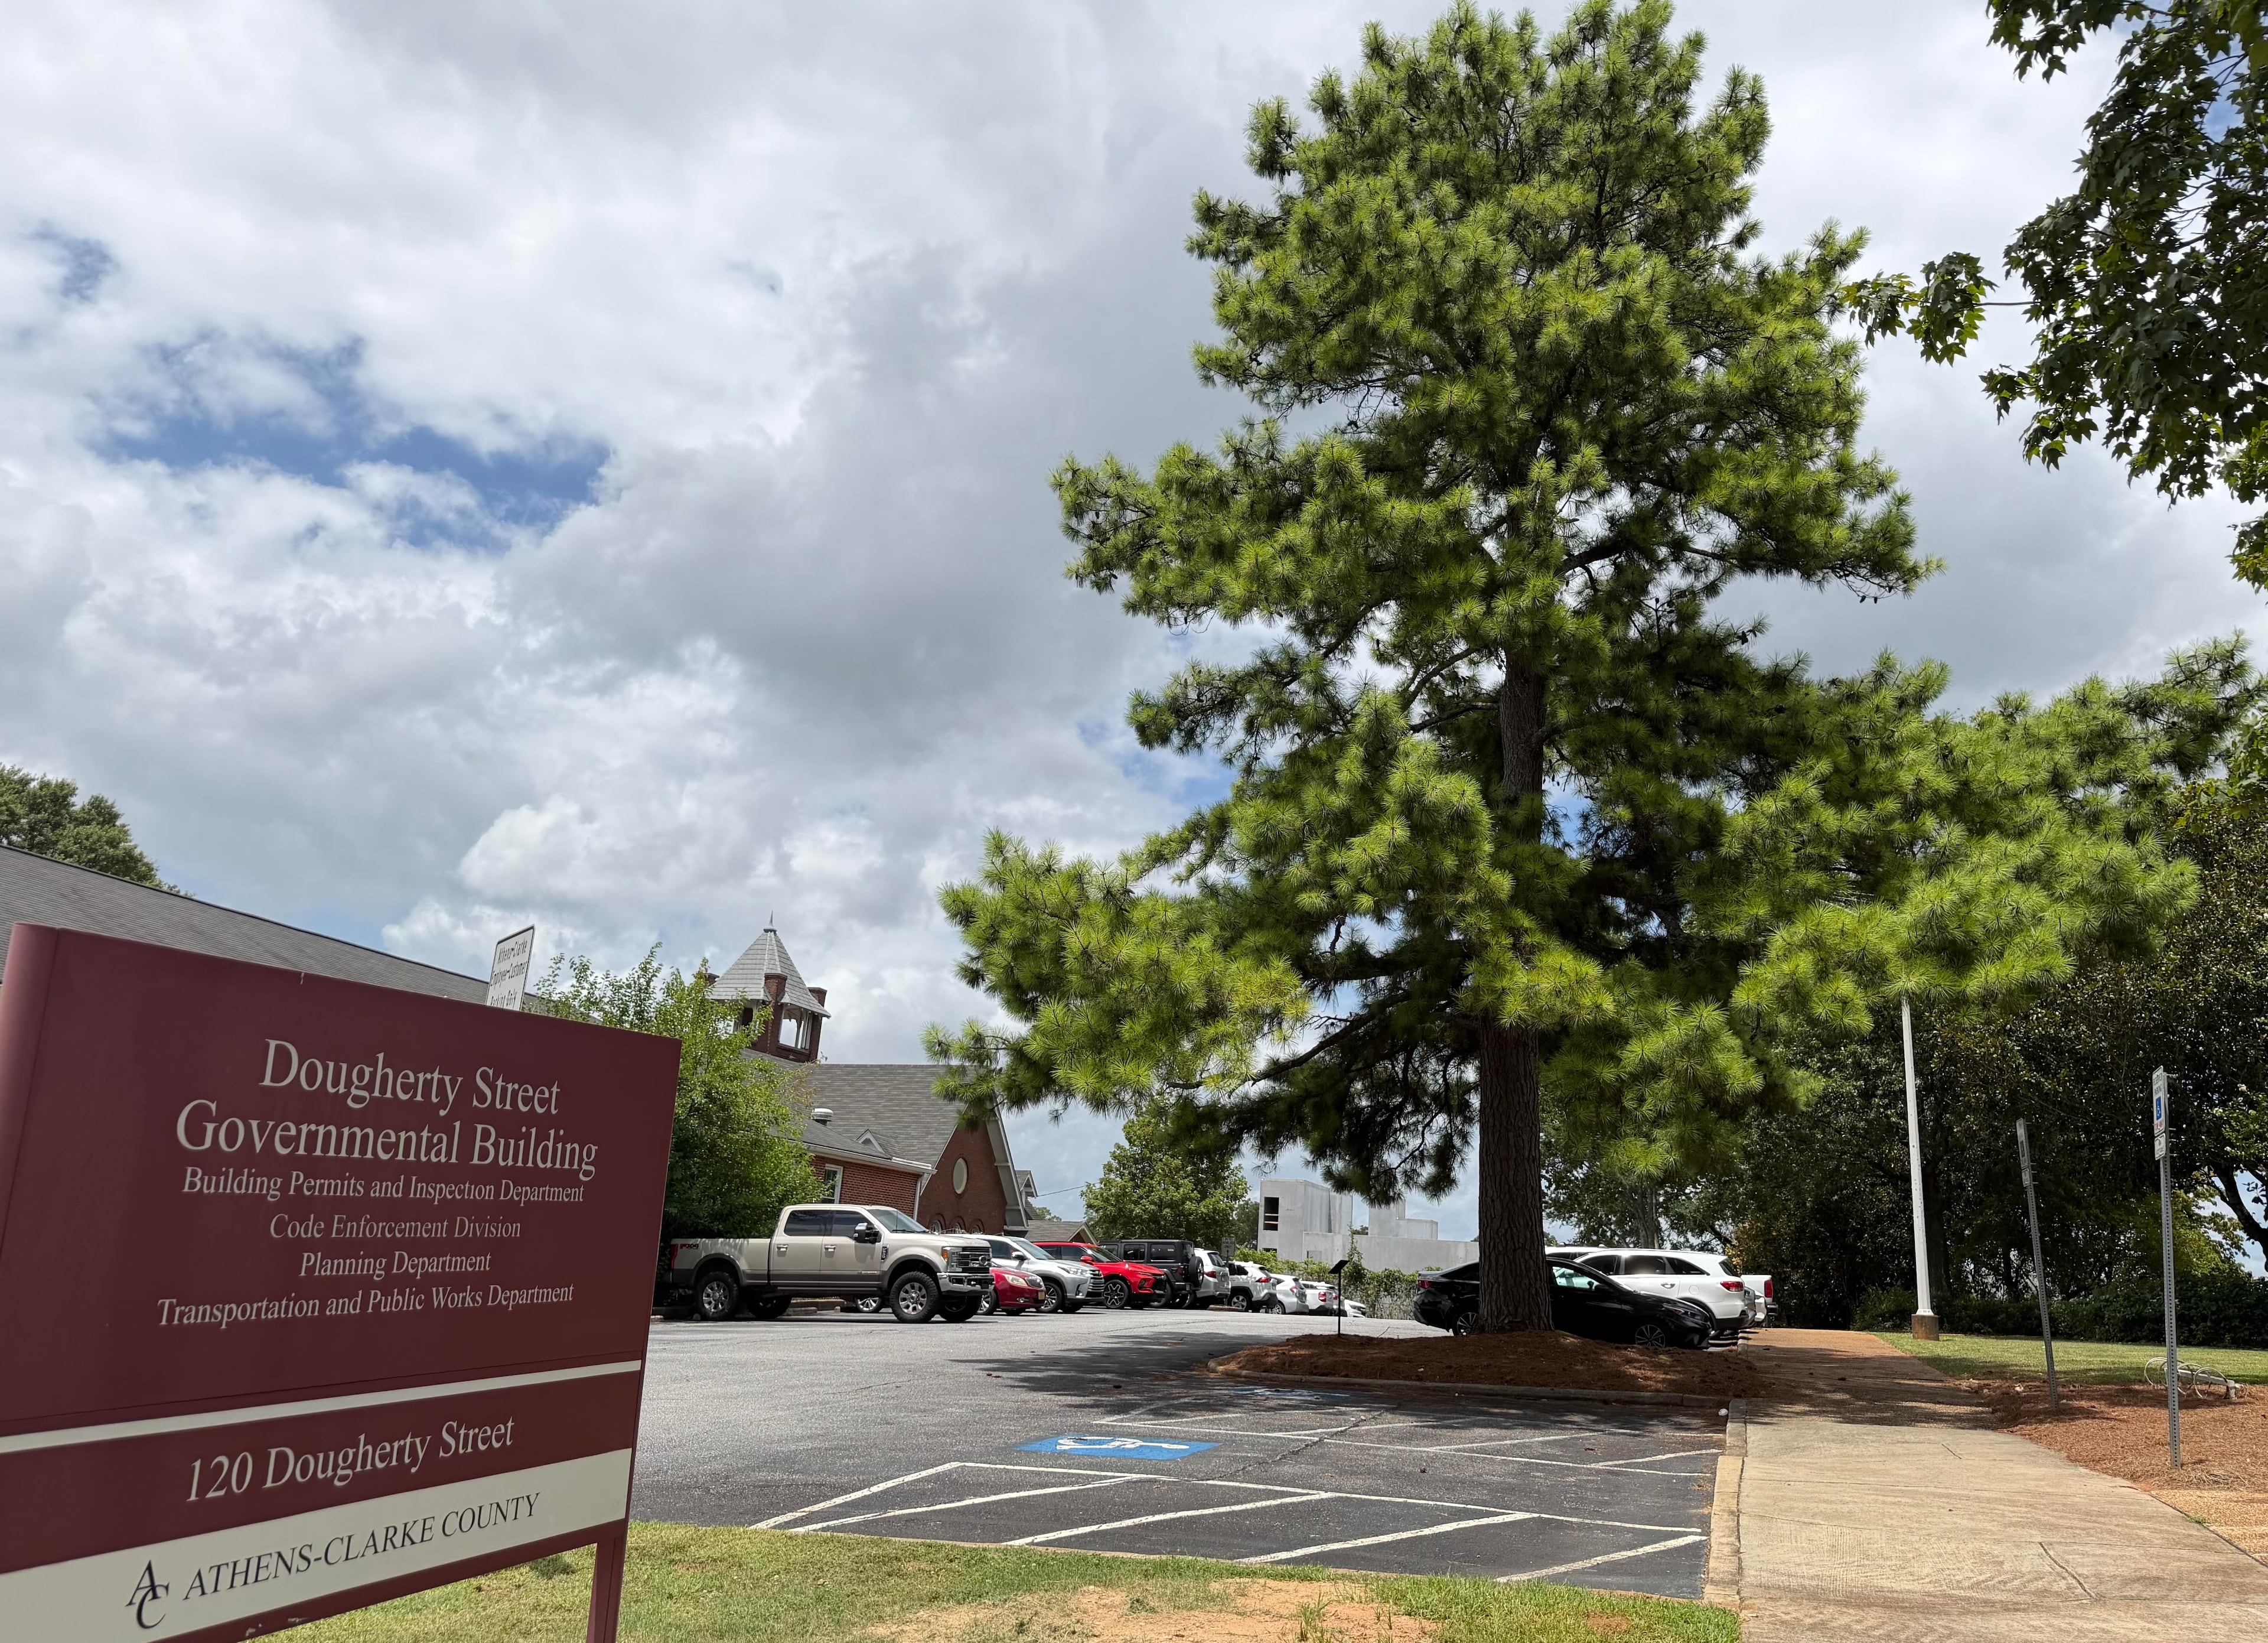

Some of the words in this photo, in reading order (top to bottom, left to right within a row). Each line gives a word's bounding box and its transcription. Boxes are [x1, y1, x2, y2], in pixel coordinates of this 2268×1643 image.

[258, 1039, 464, 1117] Dougherty
[472, 1066, 561, 1115] Street
[177, 1099, 461, 1163] Governmental
[469, 1124, 598, 1181] Building
[182, 1166, 283, 1202] Building
[288, 1170, 364, 1198] Permits
[370, 1174, 405, 1198] and
[409, 1176, 495, 1205] Inspection
[499, 1179, 584, 1206] Department
[270, 1213, 325, 1238] Code
[331, 1214, 449, 1238] Enforcement
[454, 1216, 521, 1238] Division
[299, 1251, 388, 1281] Planning
[392, 1251, 492, 1280] Department
[157, 1292, 320, 1329] Transportation
[325, 1290, 363, 1316] and
[367, 1287, 425, 1314] Public
[432, 1285, 483, 1309] Works
[487, 1283, 575, 1311] Department
[185, 1452, 253, 1501] 120
[262, 1431, 432, 1487] Dougherty
[438, 1417, 515, 1458] Street
[182, 1516, 436, 1601] ATHENS-CLARKE
[442, 1492, 540, 1538] COUNTY
